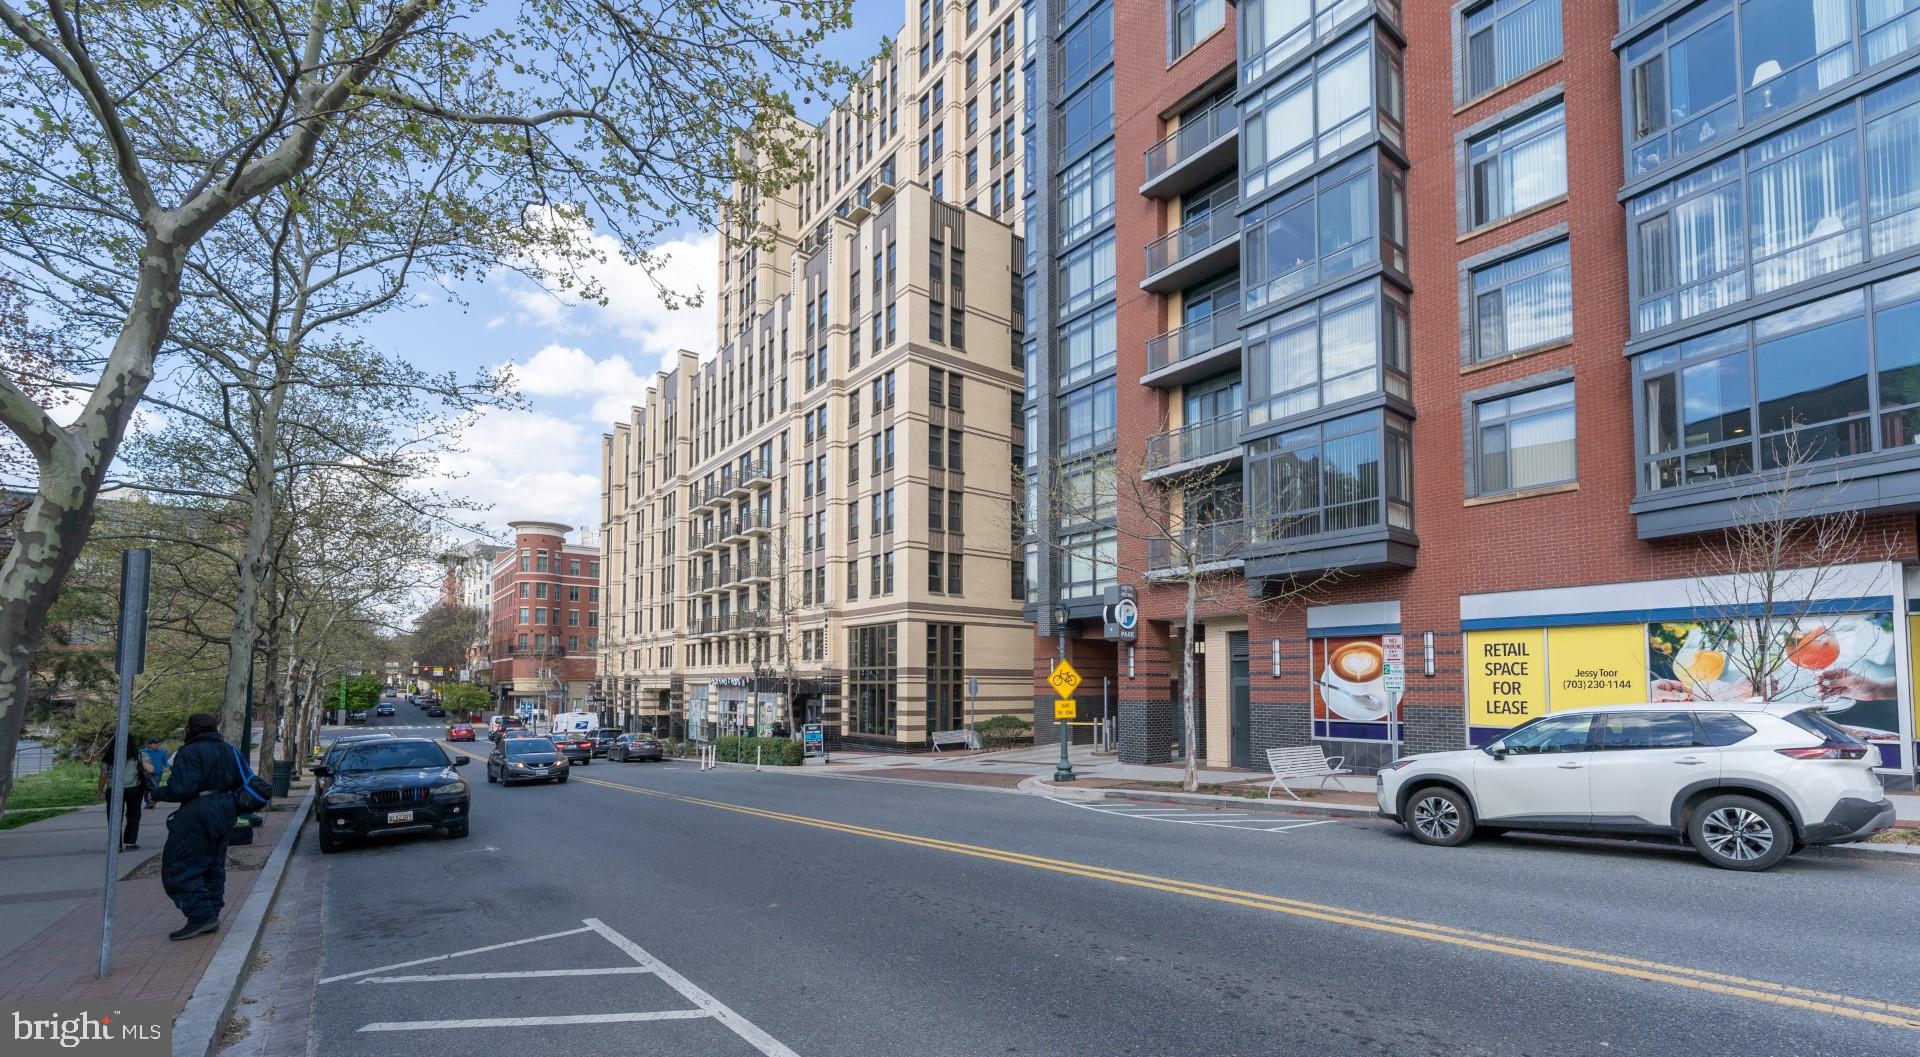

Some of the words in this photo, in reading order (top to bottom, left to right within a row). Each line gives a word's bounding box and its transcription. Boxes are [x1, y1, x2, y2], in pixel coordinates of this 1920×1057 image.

[1484, 642, 1530, 657] RETAIL
[1384, 665, 1390, 673] 2
[1485, 662, 1529, 676] SPACE
[1574, 668, 1598, 680] Jessy
[1599, 668, 1618, 677] Toor
[1493, 681, 1522, 696] FOR
[1563, 680, 1587, 690] (703)
[1587, 680, 1632, 689] 230-1144
[1486, 700, 1529, 715] LEASE
